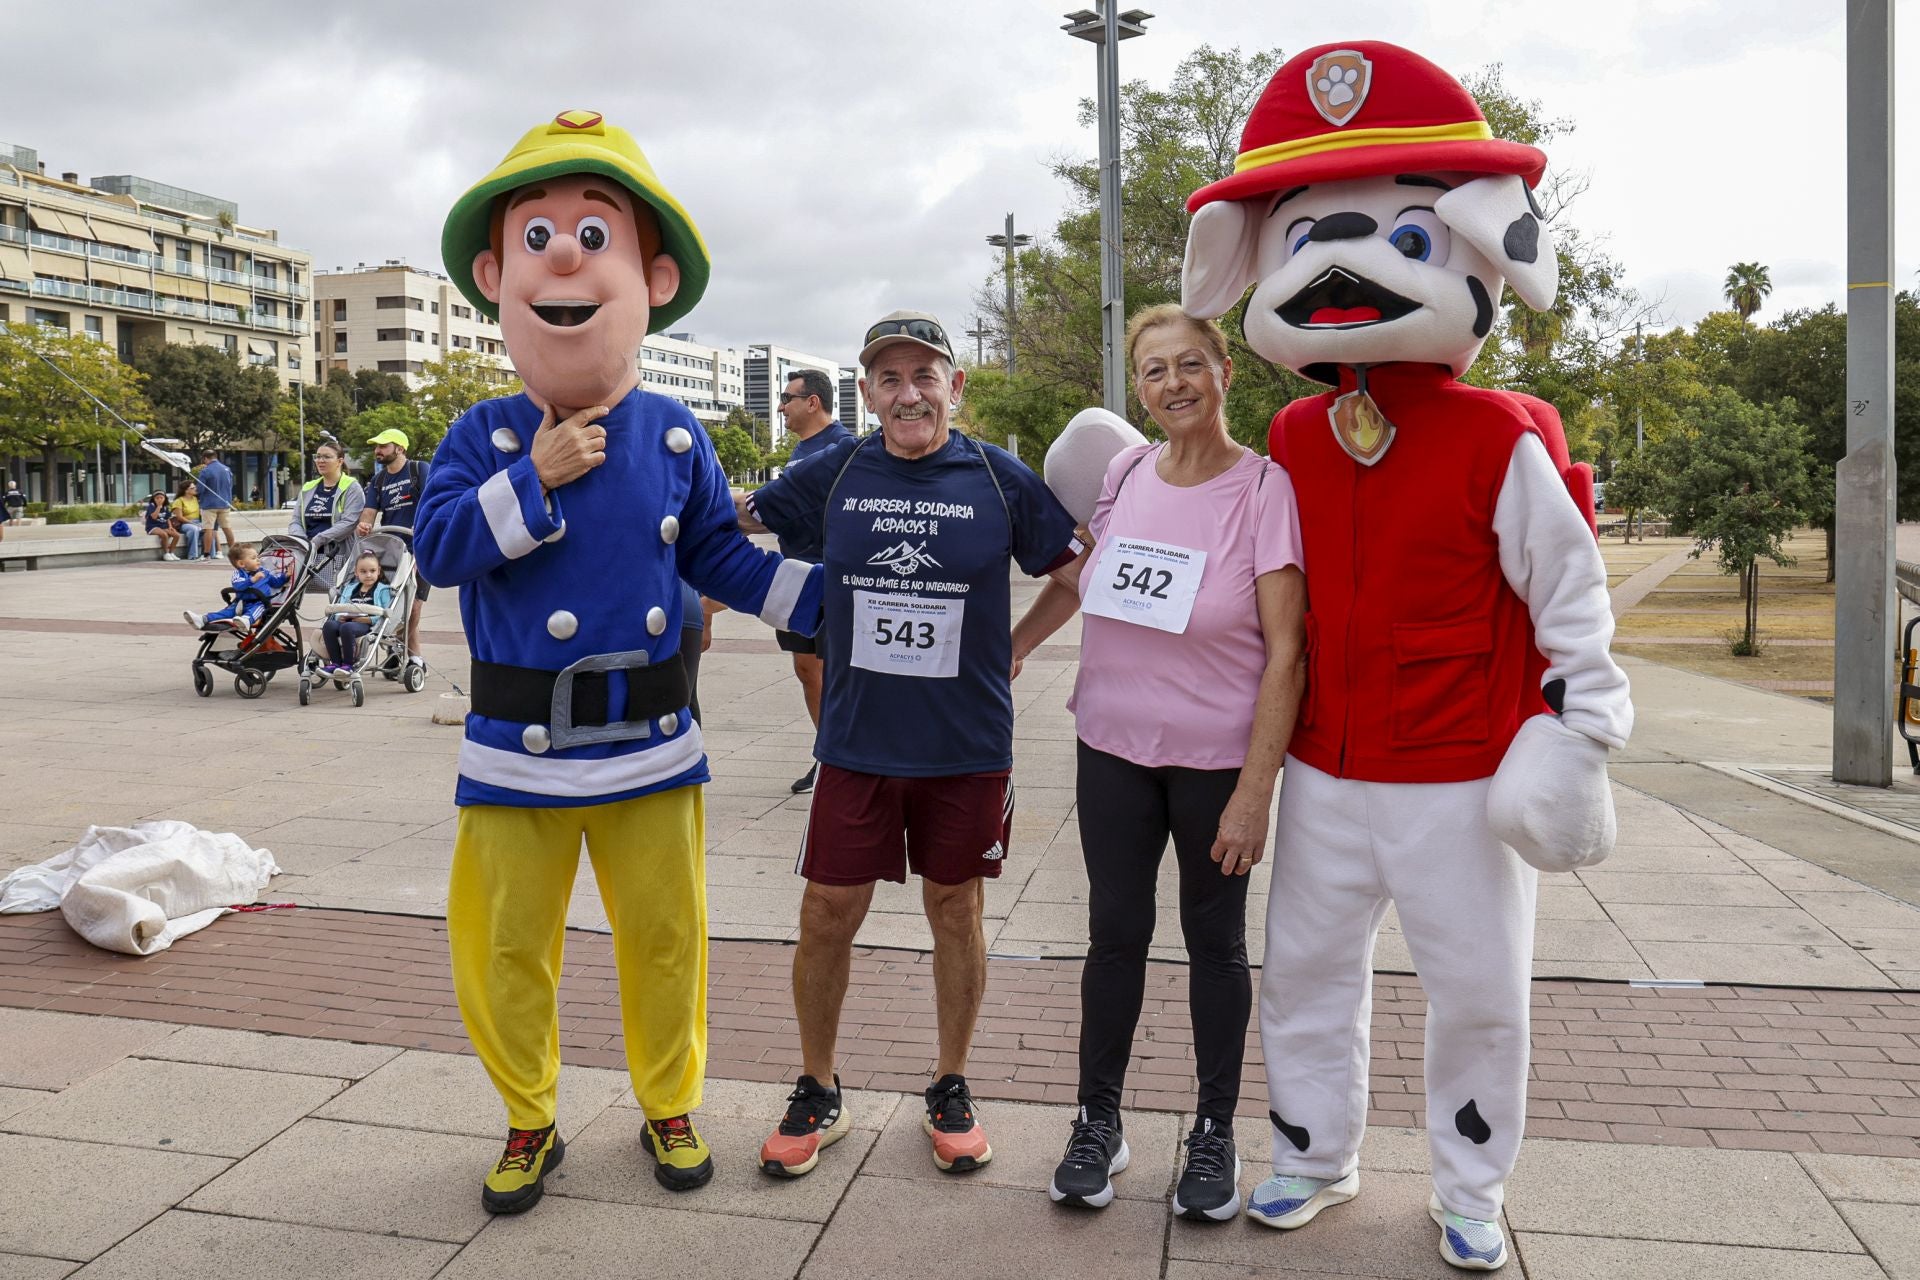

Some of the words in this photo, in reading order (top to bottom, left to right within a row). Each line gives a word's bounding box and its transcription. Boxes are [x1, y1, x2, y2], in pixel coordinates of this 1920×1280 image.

[843, 497, 858, 511] XII
[858, 498, 911, 514] CARRERA
[914, 501, 974, 520] SOLIDARIA
[871, 516, 927, 535] ACPACYS
[929, 519, 938, 536] 2025
[1128, 543, 1154, 552] CARRERA
[1155, 548, 1190, 560] SOLIDARIA
[842, 574, 850, 585] EL
[851, 574, 875, 587] ÚNICO
[876, 576, 899, 589] LÍMITE
[900, 579, 910, 590] ES
[911, 580, 924, 590] NO
[925, 582, 970, 593] INTENTARLO
[1112, 562, 1173, 600] 542
[878, 600, 909, 608] CARRERA
[874, 617, 935, 650] 543
